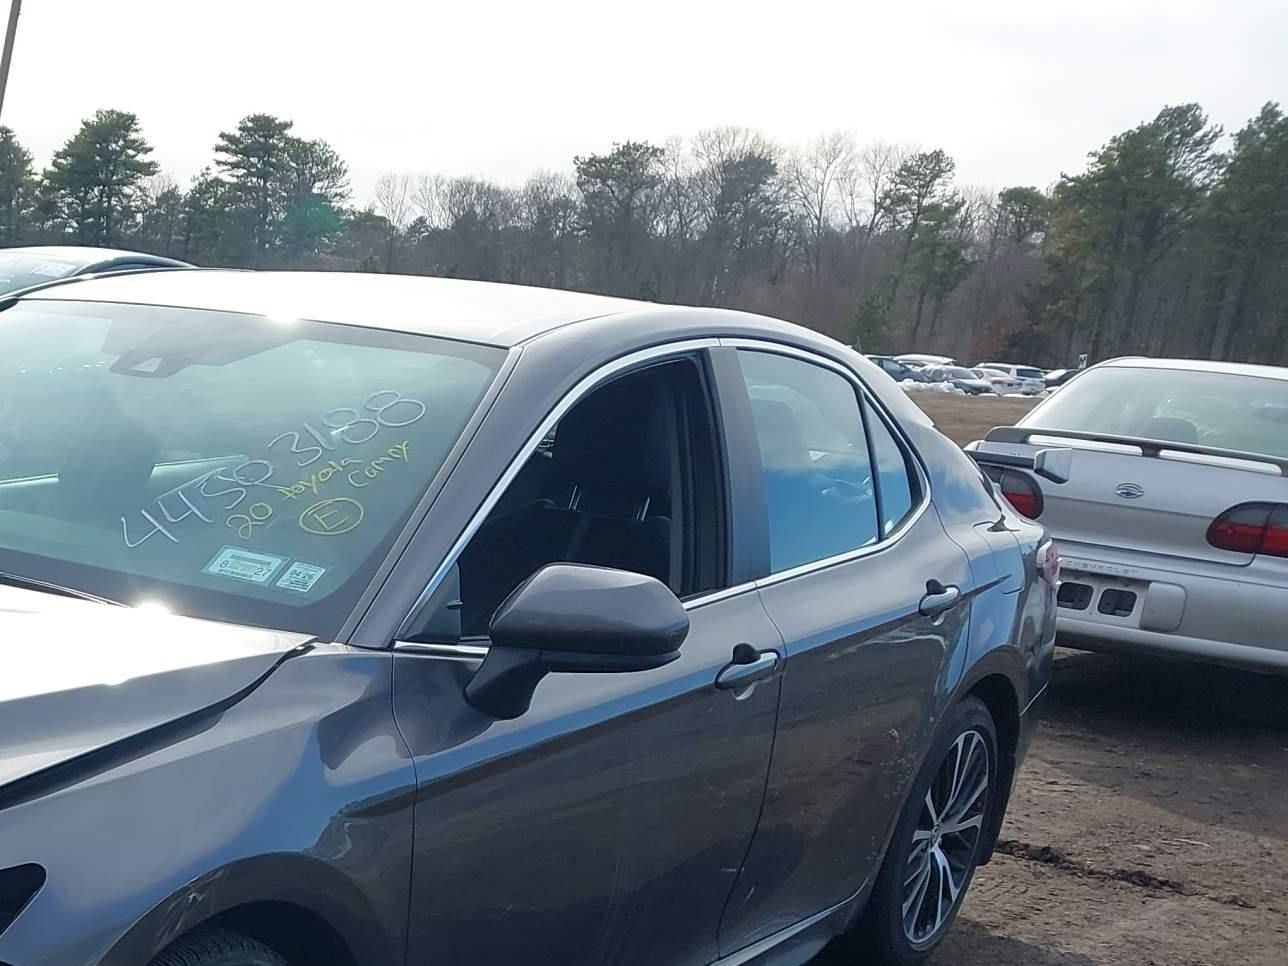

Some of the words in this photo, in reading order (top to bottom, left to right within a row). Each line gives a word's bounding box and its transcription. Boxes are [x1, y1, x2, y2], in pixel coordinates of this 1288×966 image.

[225, 502, 273, 540] 20
[220, 559, 229, 568] 8
[254, 566, 272, 577] 27
[1065, 560, 1138, 574] CHEVROLET
